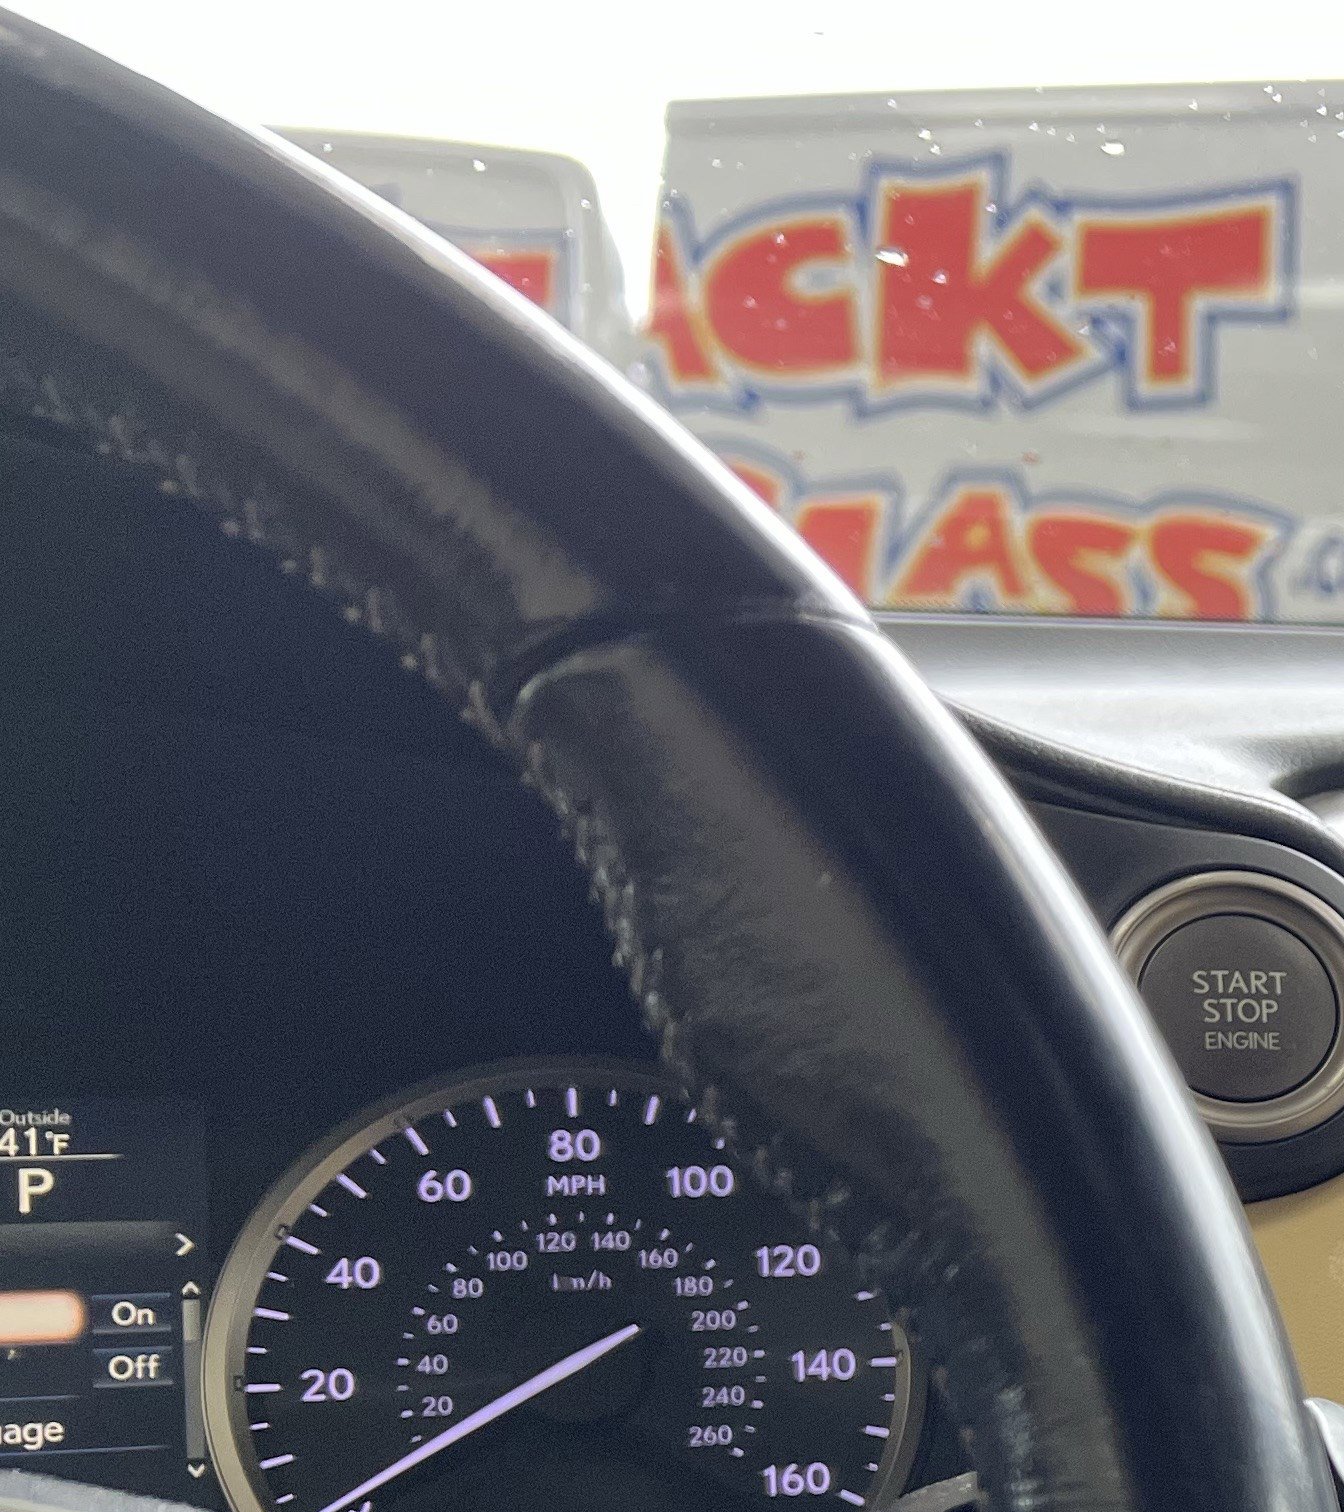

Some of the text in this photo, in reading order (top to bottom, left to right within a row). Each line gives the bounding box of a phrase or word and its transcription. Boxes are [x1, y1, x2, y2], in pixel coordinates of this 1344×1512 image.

[1192, 969, 1288, 995] START
[1202, 998, 1279, 1024] STOP
[1204, 1031, 1281, 1051] ENGINE
[0, 1108, 72, 1127] Outside
[547, 1128, 601, 1163] 80
[18, 1166, 55, 1215] P
[416, 1168, 473, 1203] 60
[546, 1174, 607, 1197] MPH
[665, 1164, 736, 1199] 100
[535, 1230, 577, 1254] 120
[590, 1229, 632, 1252] 140
[486, 1250, 529, 1272] 100
[637, 1247, 679, 1270] 160
[755, 1243, 822, 1279] 120
[325, 1255, 382, 1291] 40
[451, 1277, 485, 1300] 80
[673, 1275, 714, 1298] 180
[111, 1301, 157, 1327] On
[425, 1312, 459, 1335] 60
[690, 1308, 738, 1332] 200
[107, 1353, 161, 1382] Off
[416, 1353, 450, 1376] 40
[702, 1346, 748, 1370] 220
[790, 1347, 858, 1383] 140
[299, 1366, 357, 1403] 20
[701, 1385, 747, 1408] 240
[420, 1394, 454, 1418] 20
[0, 1420, 65, 1451] age
[687, 1424, 734, 1448] 260
[760, 1460, 832, 1498] 160
